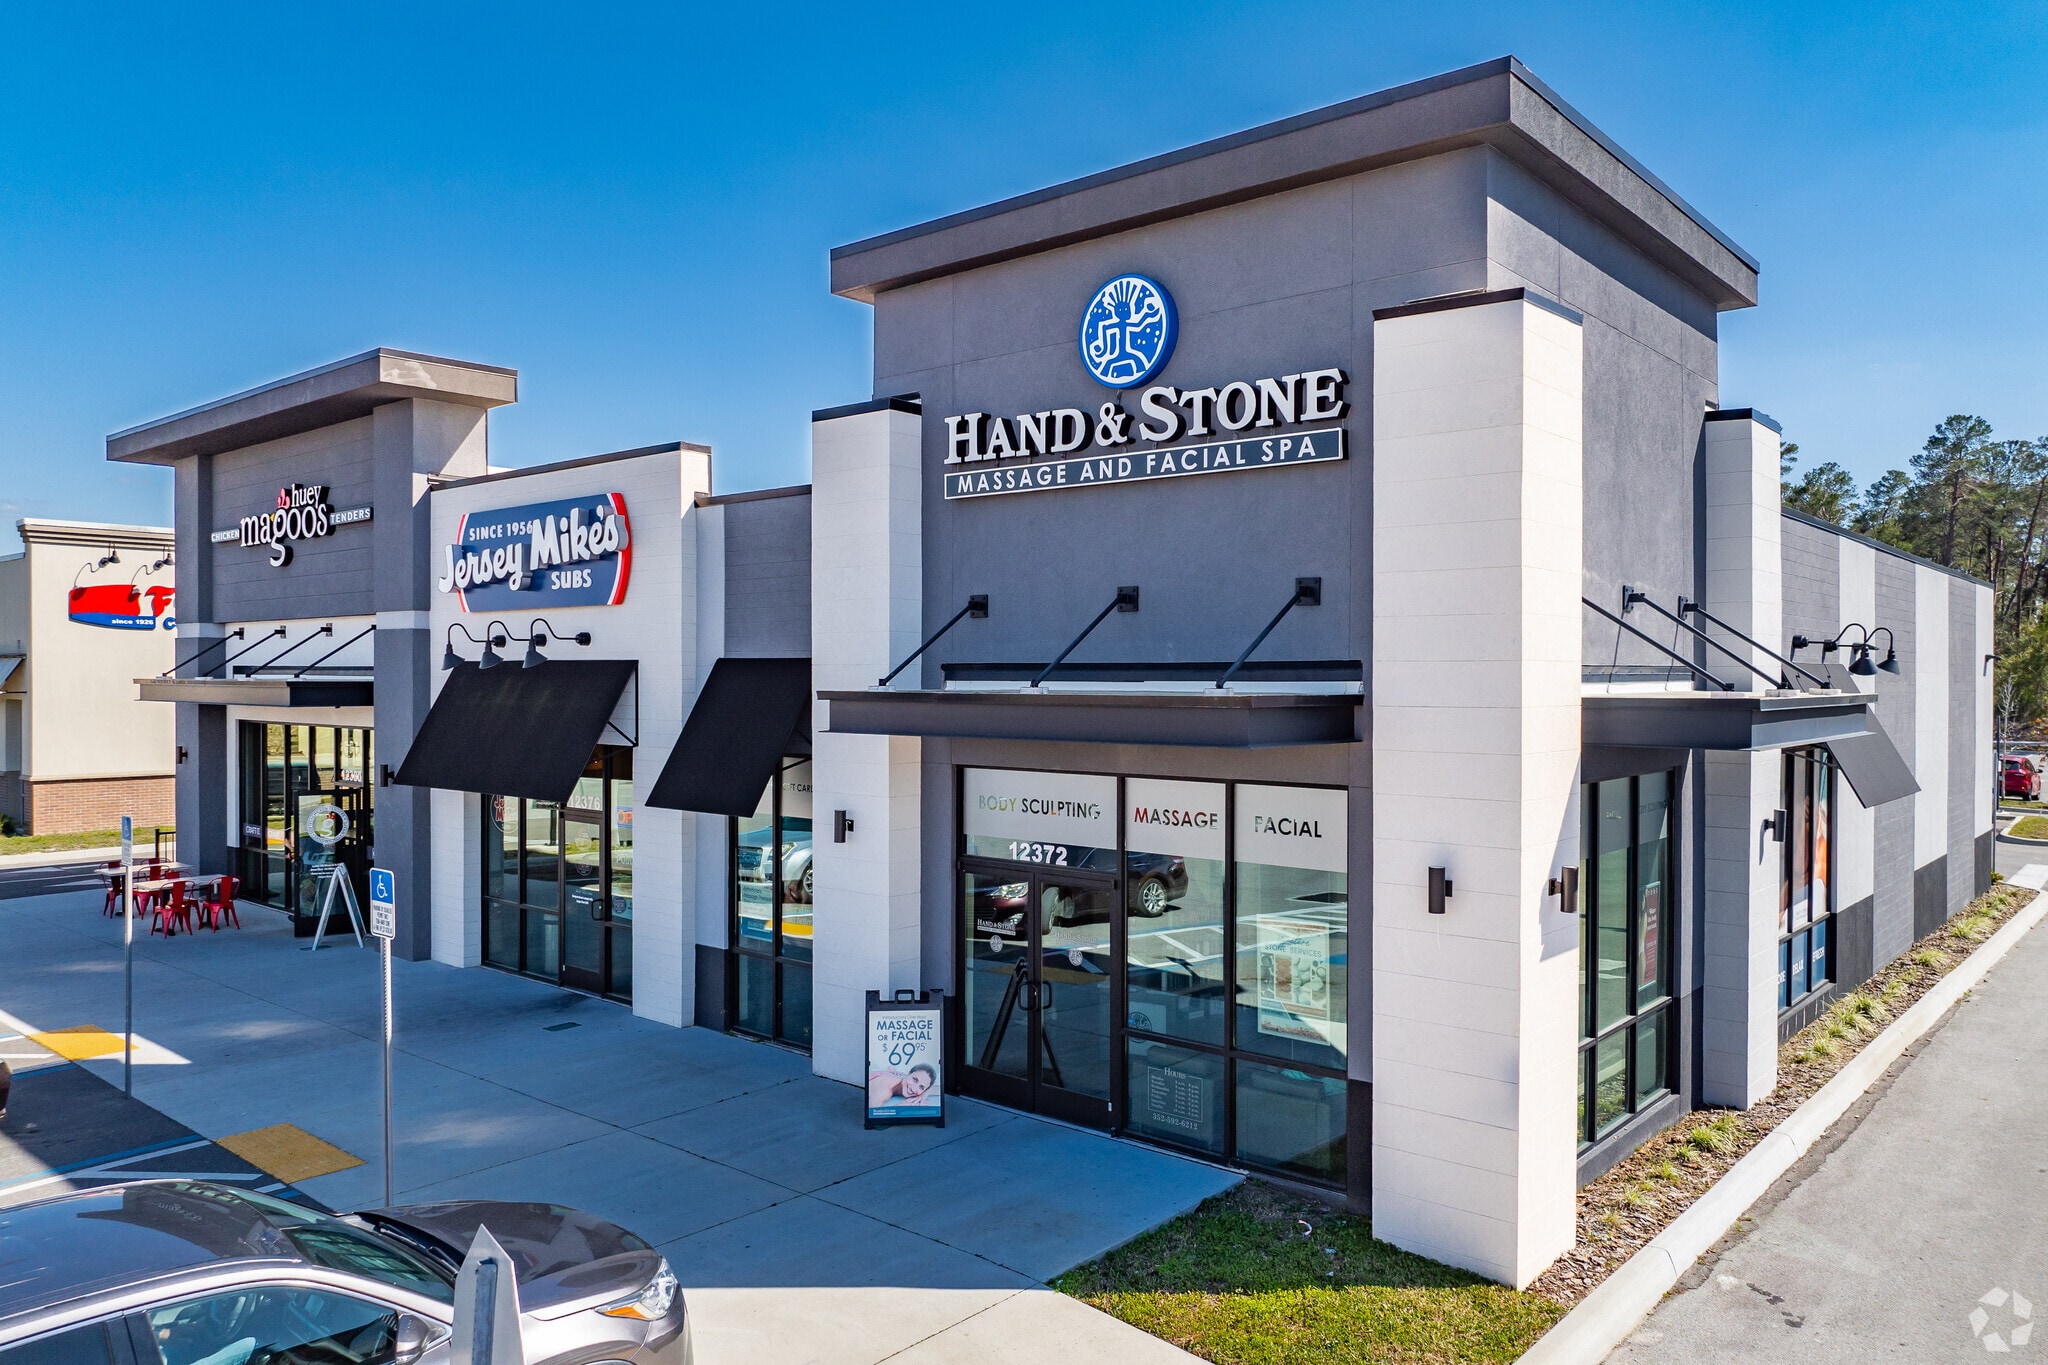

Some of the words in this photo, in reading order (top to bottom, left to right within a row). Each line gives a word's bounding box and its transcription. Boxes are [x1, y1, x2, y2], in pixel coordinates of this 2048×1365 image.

[944, 408, 1088, 465] HAND
[1095, 402, 1129, 447] &
[1139, 368, 1346, 443] STONE
[957, 464, 1067, 494] MASSAGE
[1080, 457, 1132, 482] AND
[1146, 445, 1246, 475] FACIAL
[1261, 436, 1316, 462] SPA
[291, 483, 322, 508] huey
[211, 529, 240, 542] CHICKEN
[330, 508, 371, 524] TENDERS
[469, 525, 503, 541] SINCE
[506, 522, 533, 536] 1956
[438, 544, 525, 594] Jersey
[530, 505, 620, 571] Mike's
[551, 569, 592, 590] SUBS
[978, 795, 1017, 812] BODY
[1021, 798, 1101, 820] SCULPTING
[1134, 807, 1218, 830] MASSAGE
[1254, 815, 1322, 838] FACIAL
[1009, 841, 1068, 867] 12372
[977, 919, 994, 928] HAND
[1264, 943, 1286, 953] STONE
[1289, 946, 1322, 958] SERVICES
[876, 1020, 933, 1031] MASSAGE
[891, 1031, 932, 1041] FACIAL
[1164, 1067, 1187, 1079] HOURS
